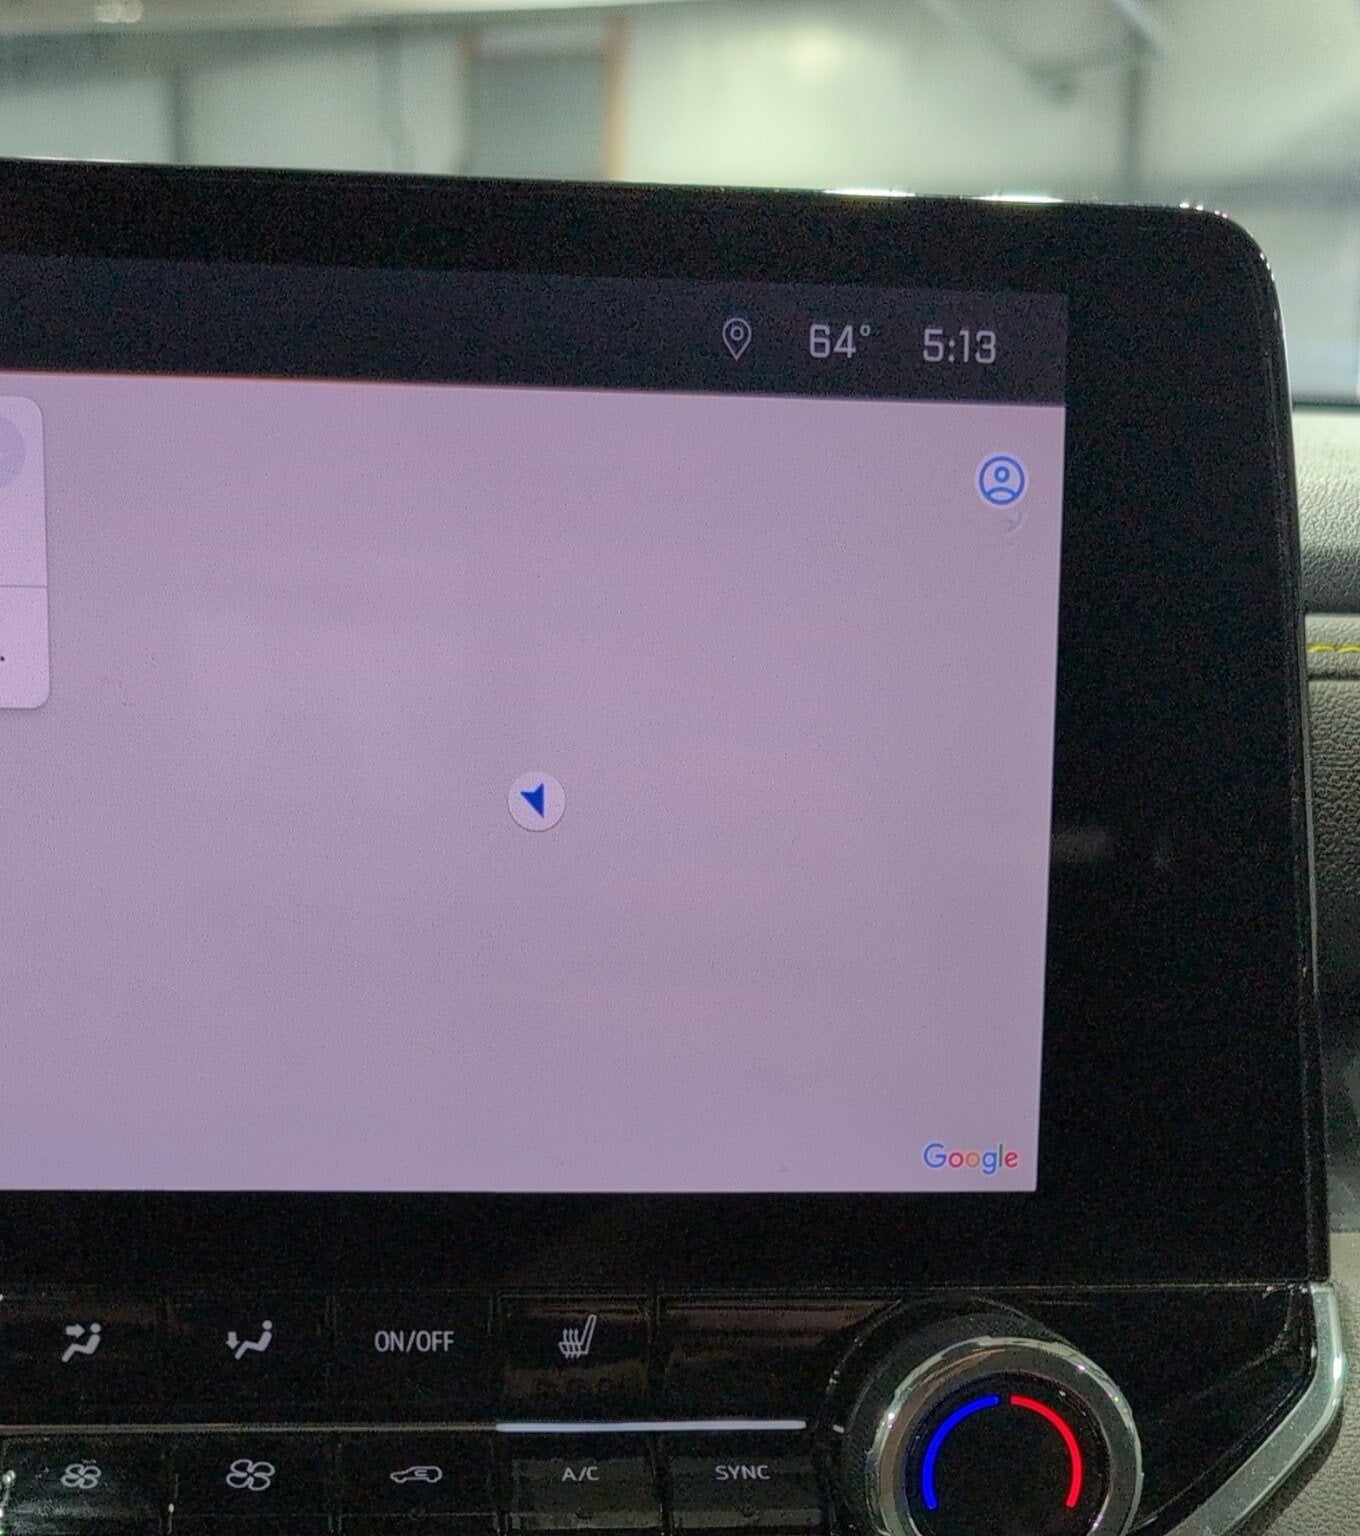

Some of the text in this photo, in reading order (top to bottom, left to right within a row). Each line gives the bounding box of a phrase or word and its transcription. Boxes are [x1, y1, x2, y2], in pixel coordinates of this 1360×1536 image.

[922, 327, 997, 364] 5:13
[923, 1142, 1019, 1175] Google
[374, 1329, 455, 1353] ON/OFF
[561, 1466, 600, 1482] A/C
[714, 1464, 772, 1481] SYNC
